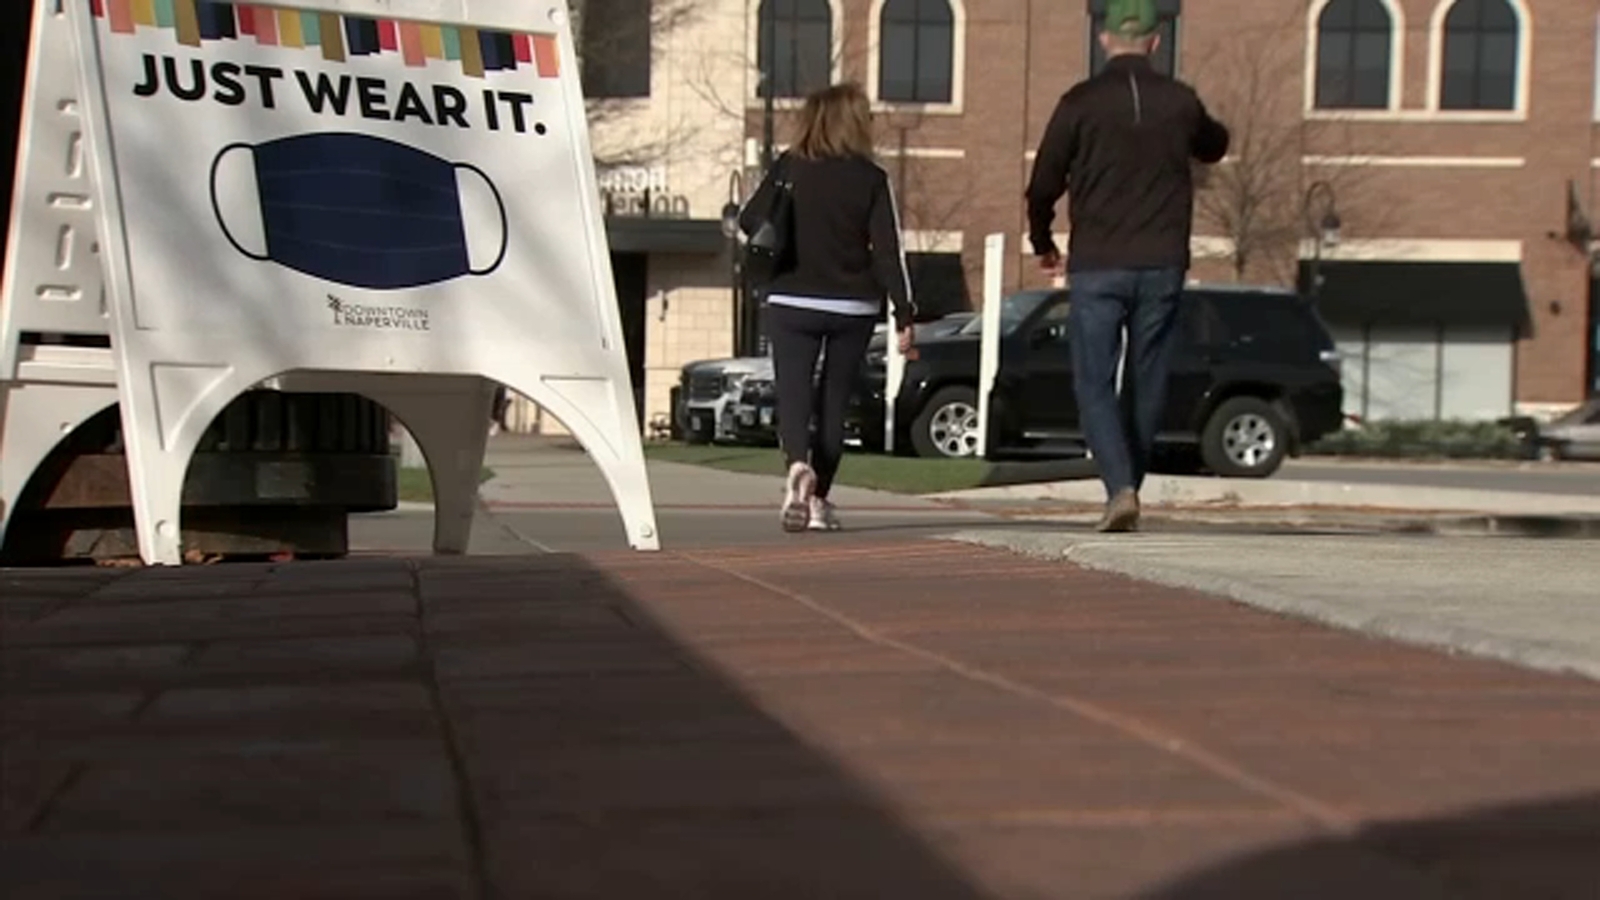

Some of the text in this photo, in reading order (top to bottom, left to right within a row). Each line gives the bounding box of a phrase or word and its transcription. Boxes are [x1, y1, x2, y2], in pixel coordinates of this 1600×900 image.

[133, 54, 547, 135] JUST WEAR IT.
[343, 304, 429, 319] DOWNTOWN
[344, 316, 431, 331] NAPERVILLE
